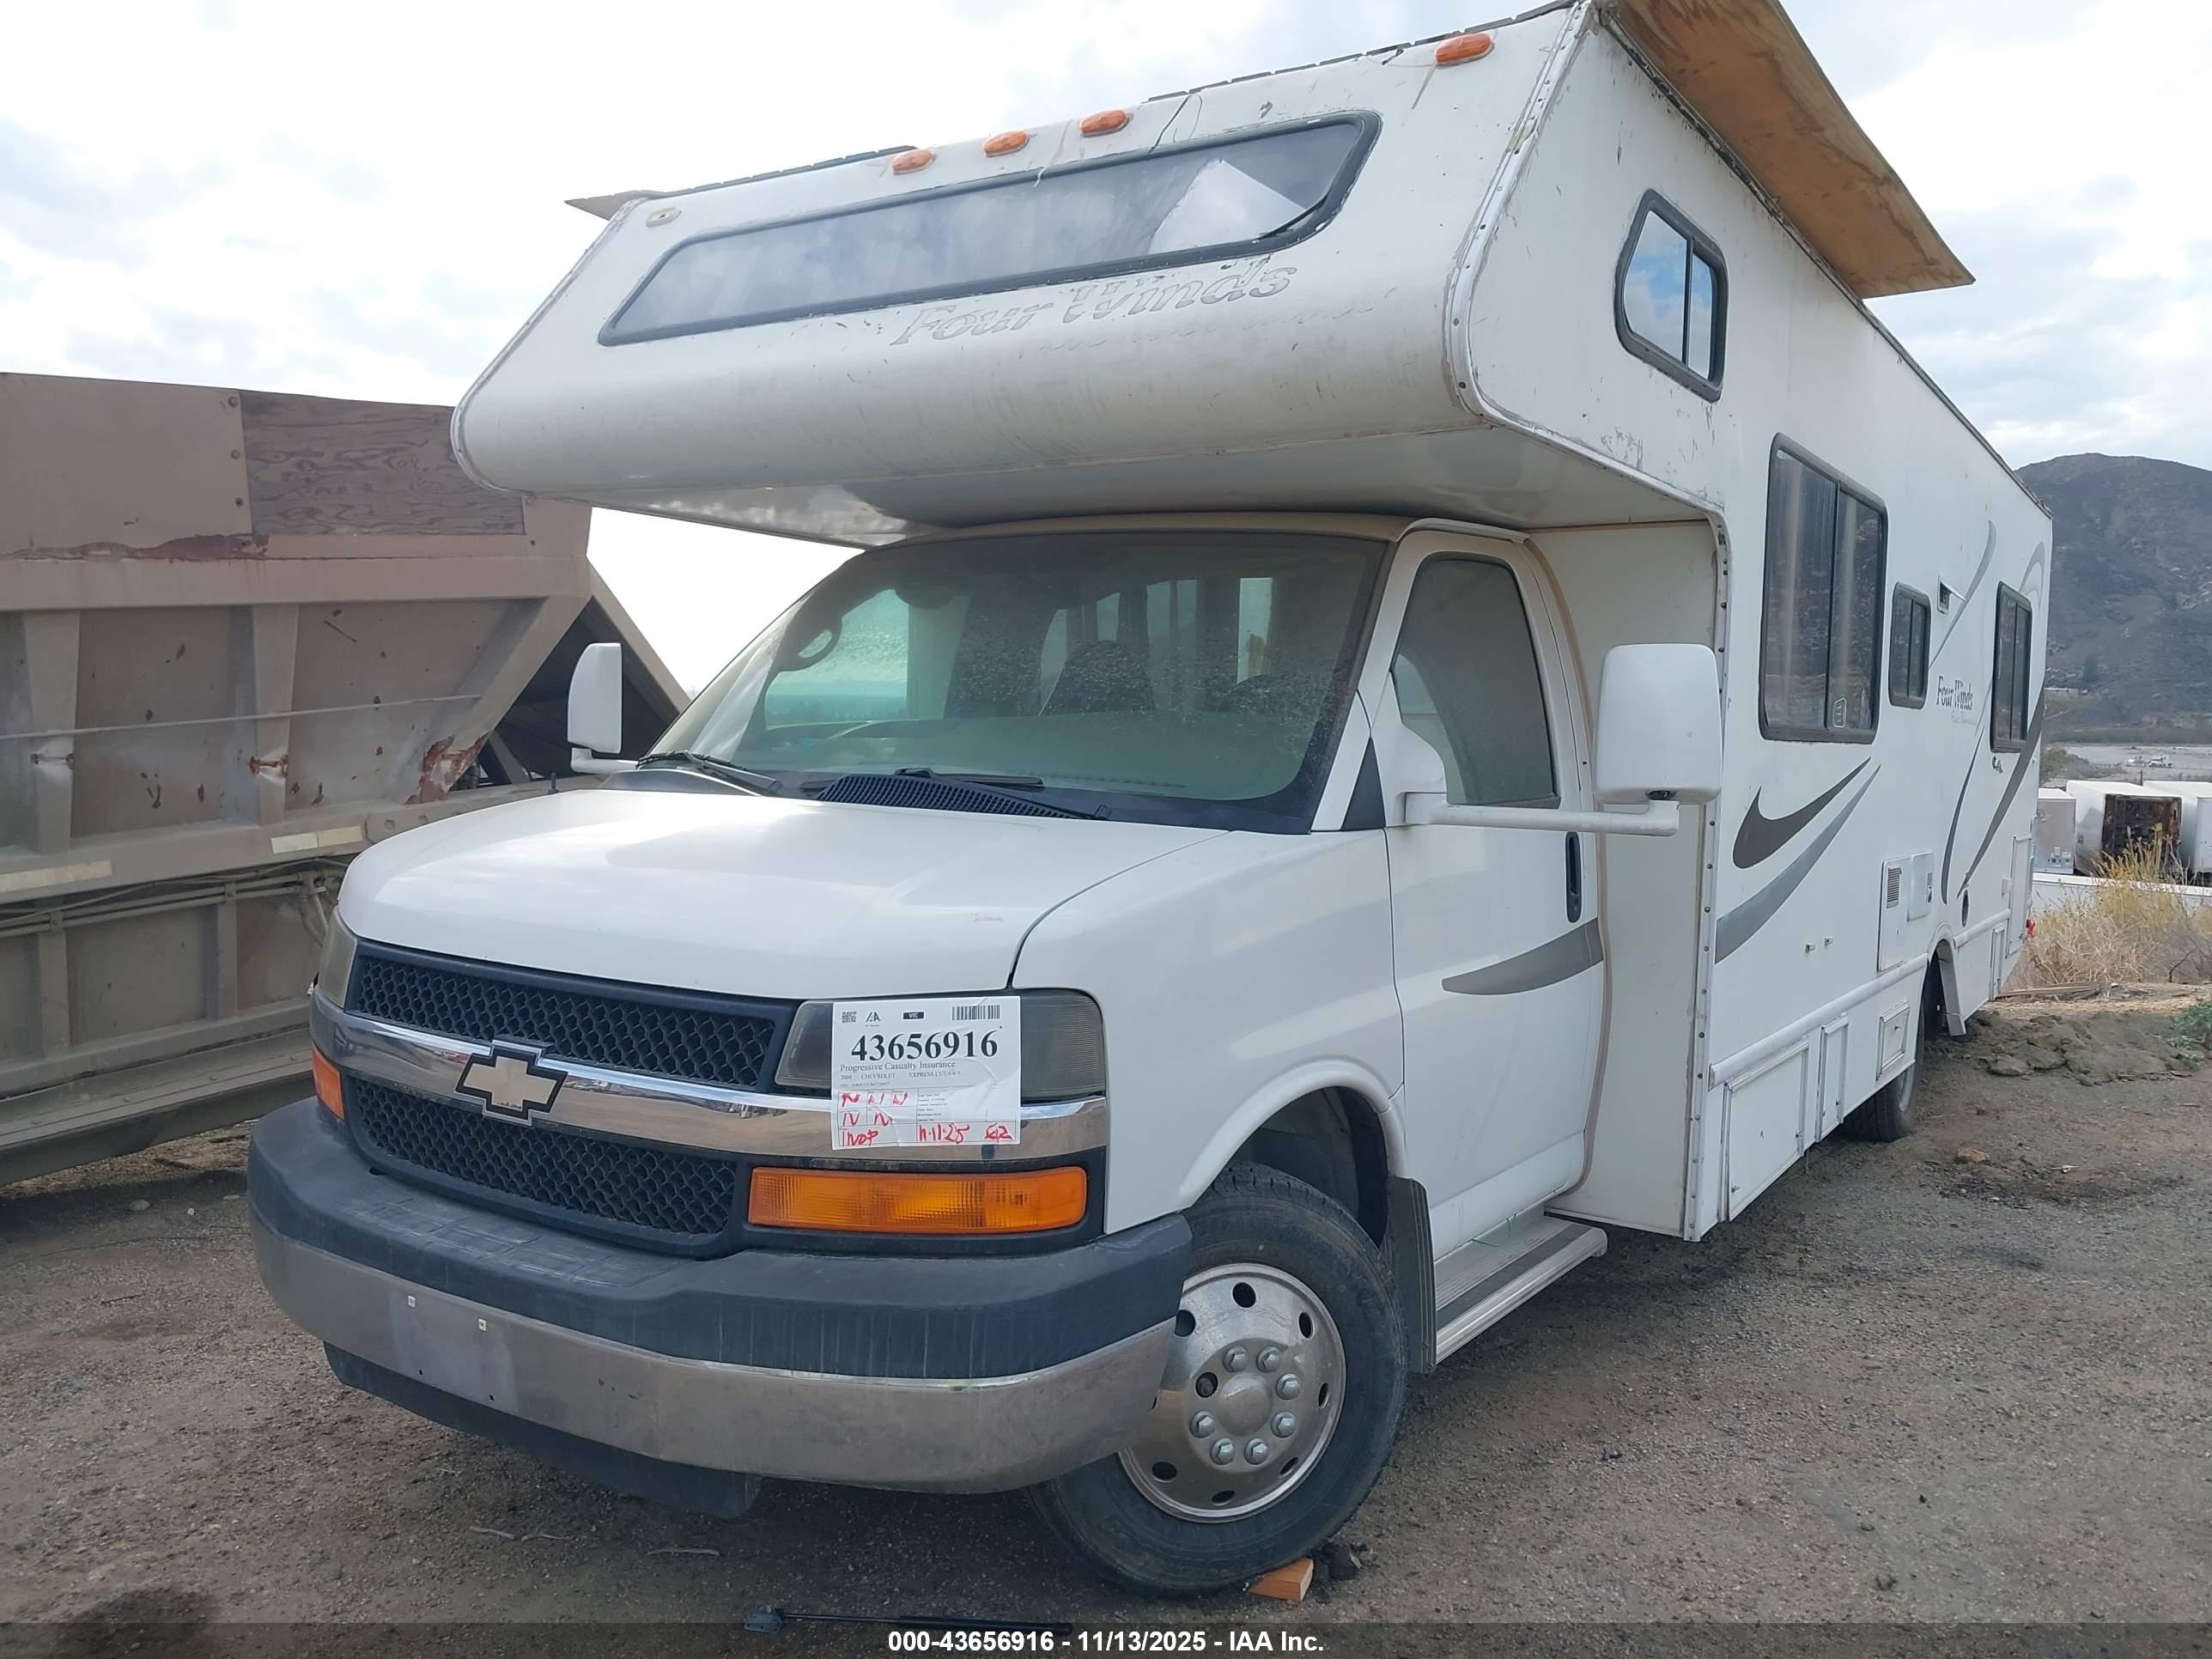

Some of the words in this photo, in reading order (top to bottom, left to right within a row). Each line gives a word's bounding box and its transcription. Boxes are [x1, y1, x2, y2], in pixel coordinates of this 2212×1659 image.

[889, 304, 1054, 346] Four
[1062, 255, 1297, 325] Winds
[1936, 675, 1954, 708] Four
[851, 1030, 1000, 1061] 43656916
[840, 1063, 884, 1073] Progressive
[884, 1062, 916, 1072] Casualty
[920, 1060, 956, 1069] Insurance
